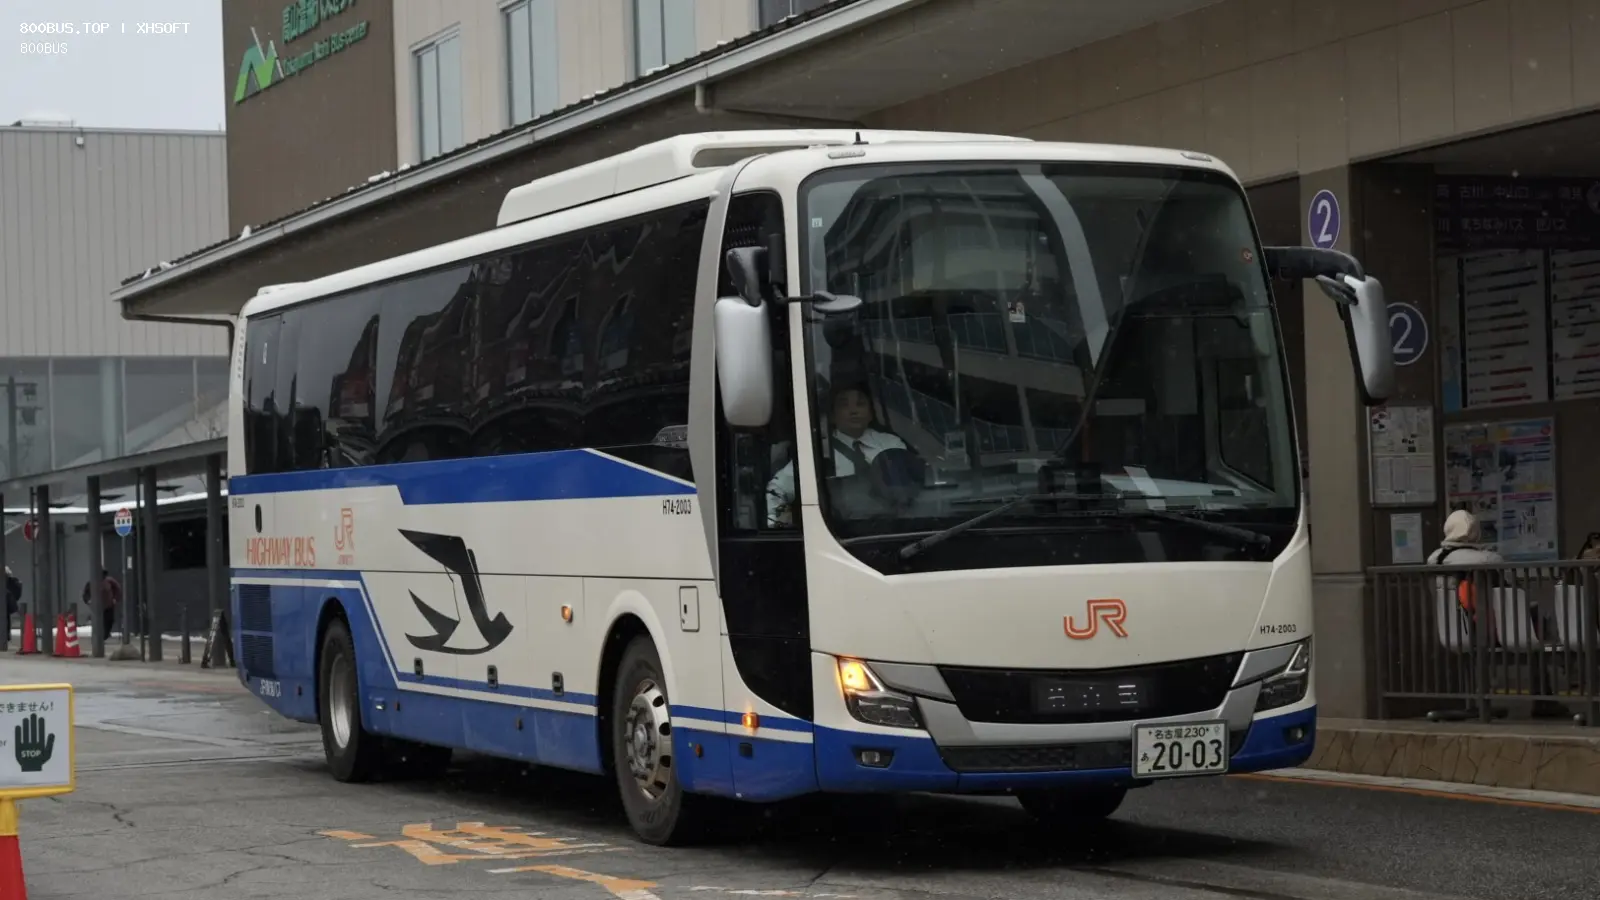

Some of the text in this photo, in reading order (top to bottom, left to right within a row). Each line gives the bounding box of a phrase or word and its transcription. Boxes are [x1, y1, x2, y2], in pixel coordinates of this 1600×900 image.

[1317, 199, 1332, 243] 2
[1389, 312, 1414, 354] 2
[662, 499, 692, 515] H74-2003
[334, 507, 354, 551] JR
[246, 536, 316, 567] HIGHWAY BUS
[1063, 598, 1129, 640] JR
[1260, 623, 1297, 635] H74-2003
[21, 750, 42, 759] STOP
[1140, 739, 1223, 771] あ 20-03
